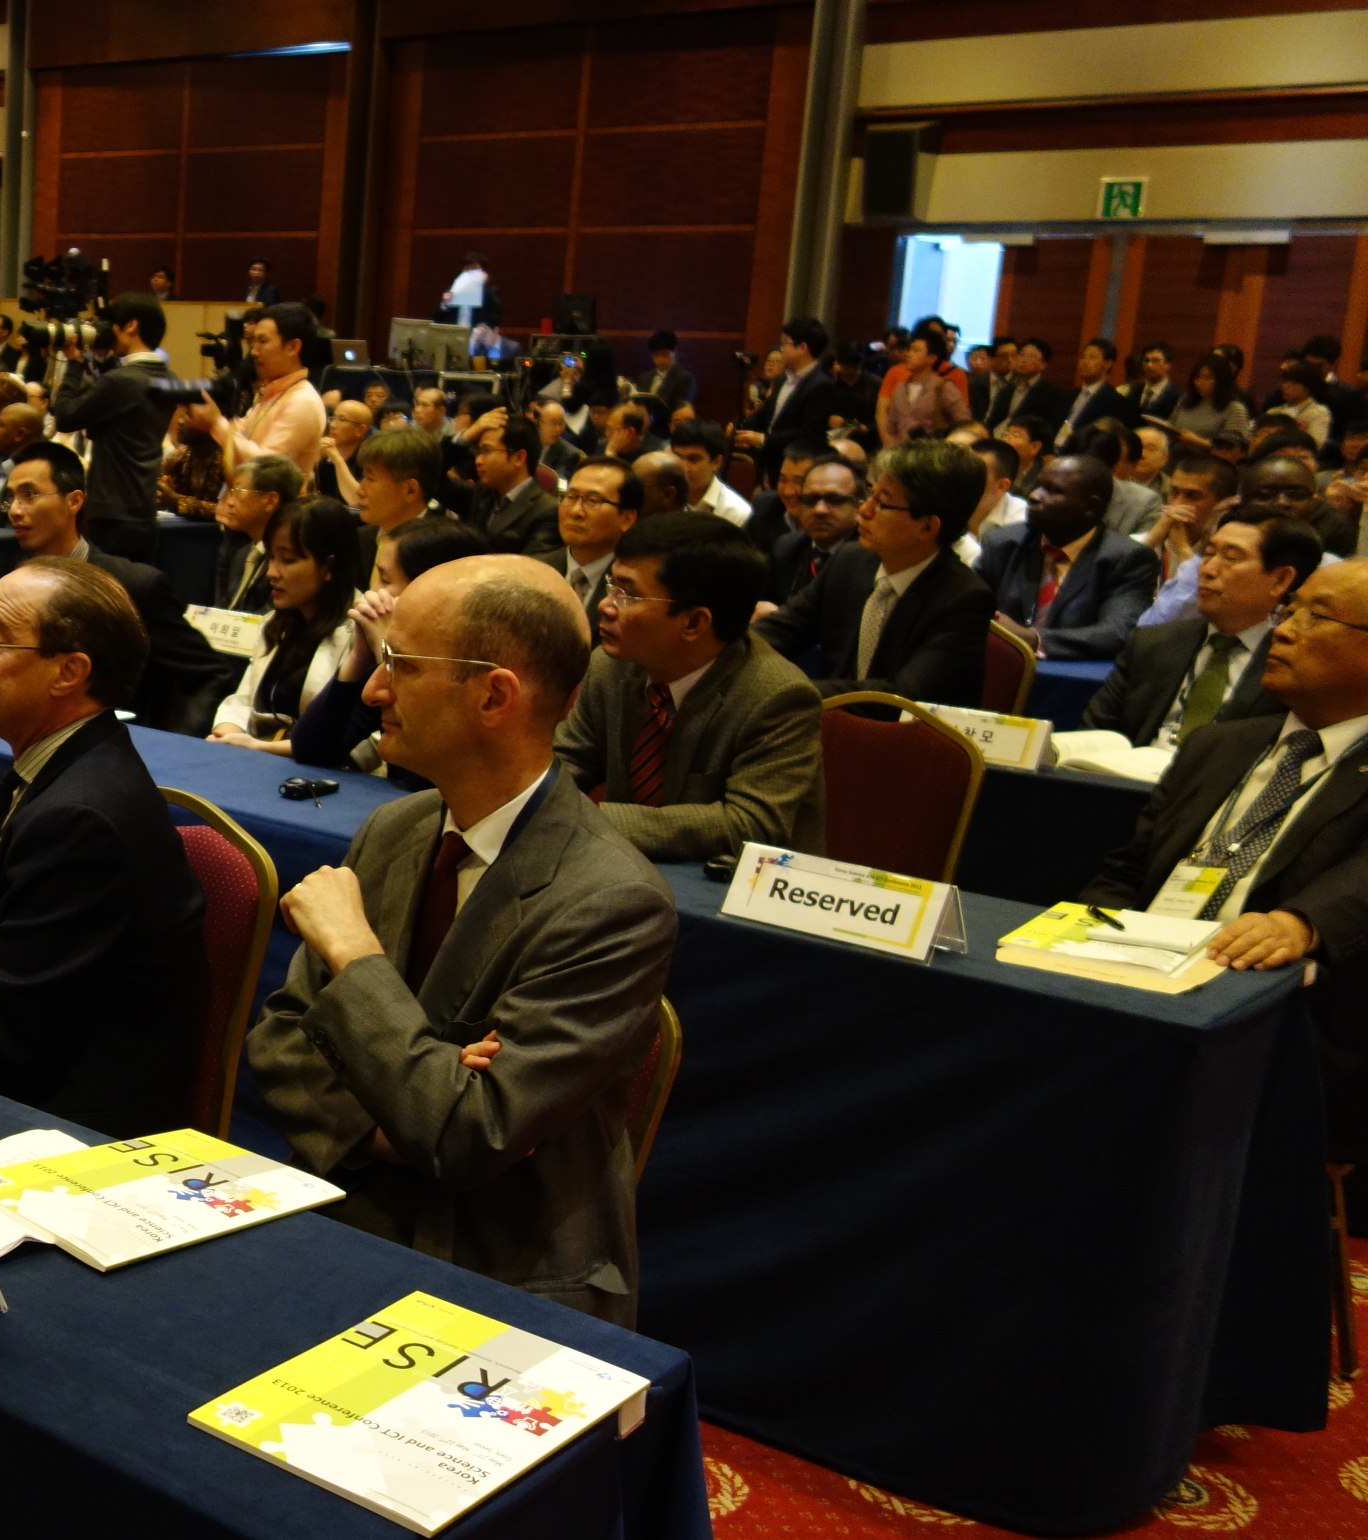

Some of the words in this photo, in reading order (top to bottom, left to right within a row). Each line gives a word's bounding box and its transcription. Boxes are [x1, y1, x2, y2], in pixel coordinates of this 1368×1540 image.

[768, 878, 900, 925] Reserved
[32, 1163, 57, 1174] 2013
[108, 1139, 229, 1191] RISE
[54, 1174, 105, 1199] Conference
[101, 1199, 121, 1207] ICT
[117, 1207, 139, 1217] and
[131, 1225, 165, 1241] Korea
[135, 1217, 176, 1238] Science
[340, 1320, 512, 1401] RISE
[270, 1378, 306, 1395] 2013
[303, 1393, 381, 1429] Conference
[380, 1428, 405, 1440] ICT
[404, 1438, 435, 1453] and
[433, 1450, 491, 1478] Science
[434, 1462, 481, 1484] Korea
